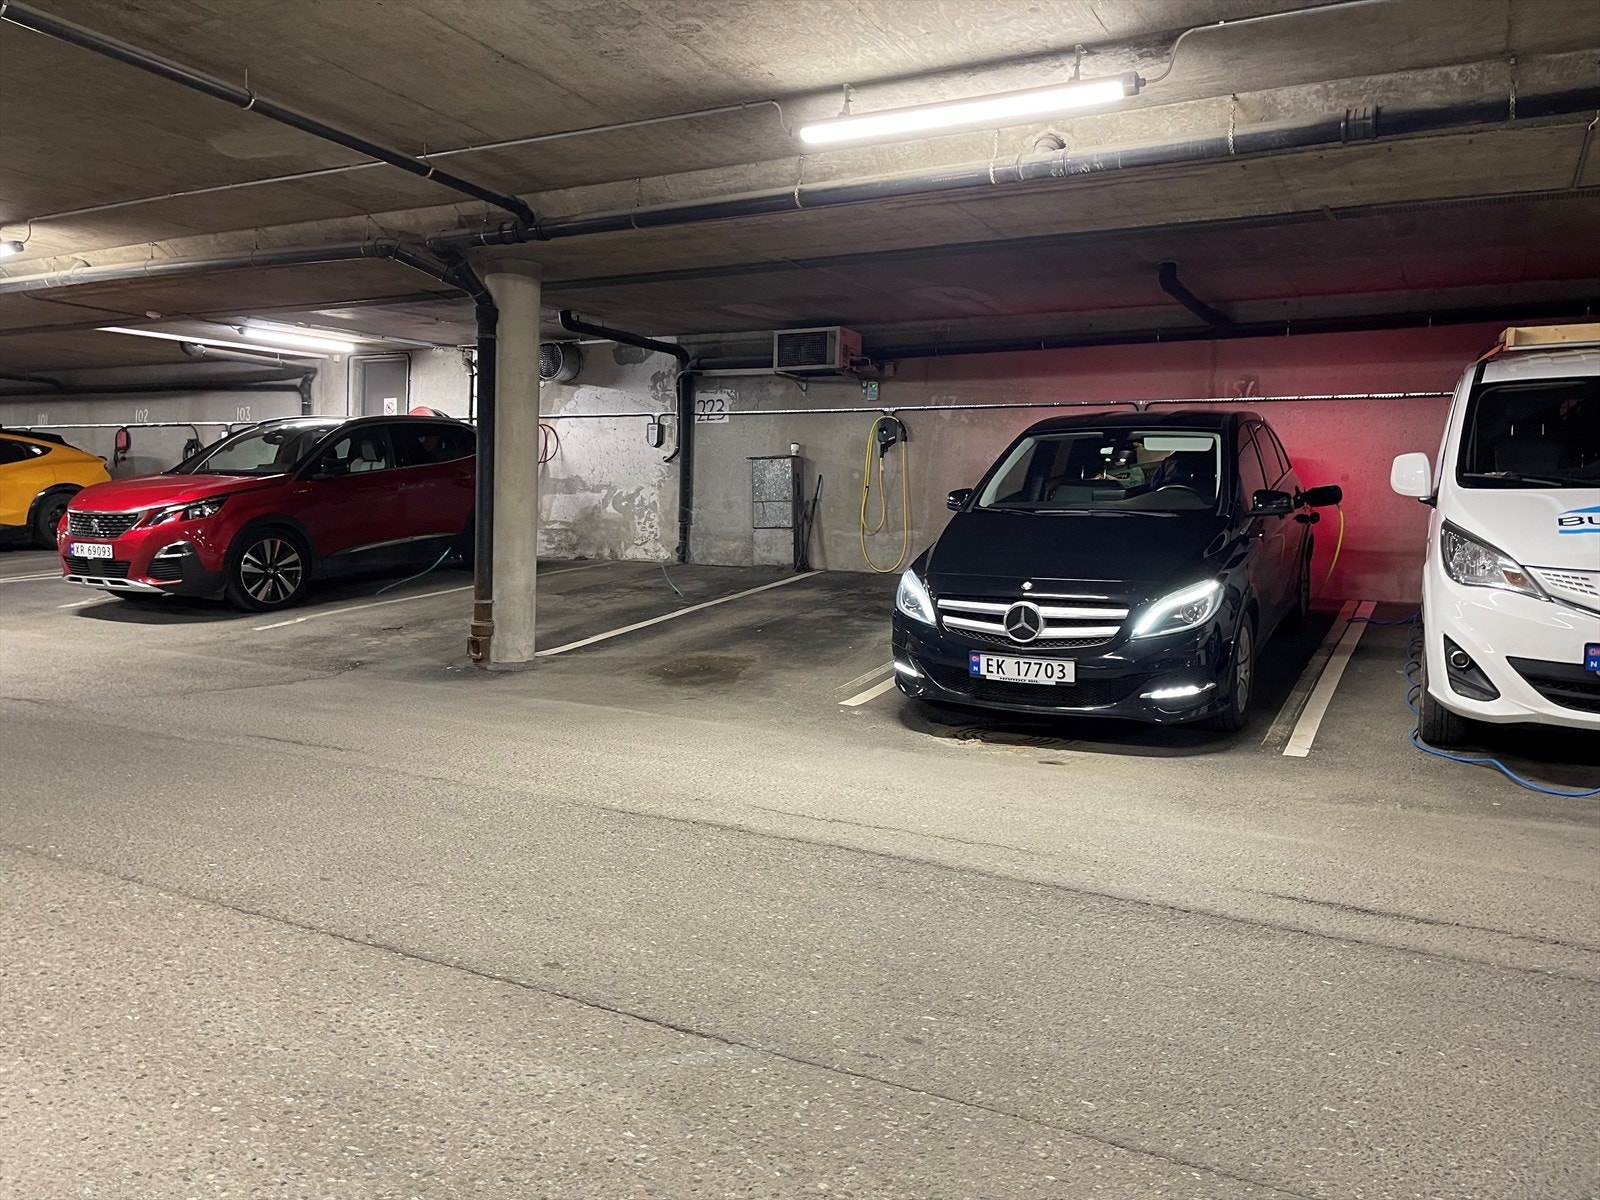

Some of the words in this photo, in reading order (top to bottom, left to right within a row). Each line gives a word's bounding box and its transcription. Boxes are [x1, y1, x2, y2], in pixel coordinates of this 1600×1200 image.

[135, 408, 149, 423] 102
[236, 406, 251, 421] 103
[696, 398, 726, 421] 223
[75, 545, 85, 555] XR
[87, 545, 111, 557] 69093
[986, 657, 1006, 675] EK
[1014, 660, 1066, 680] 17703
